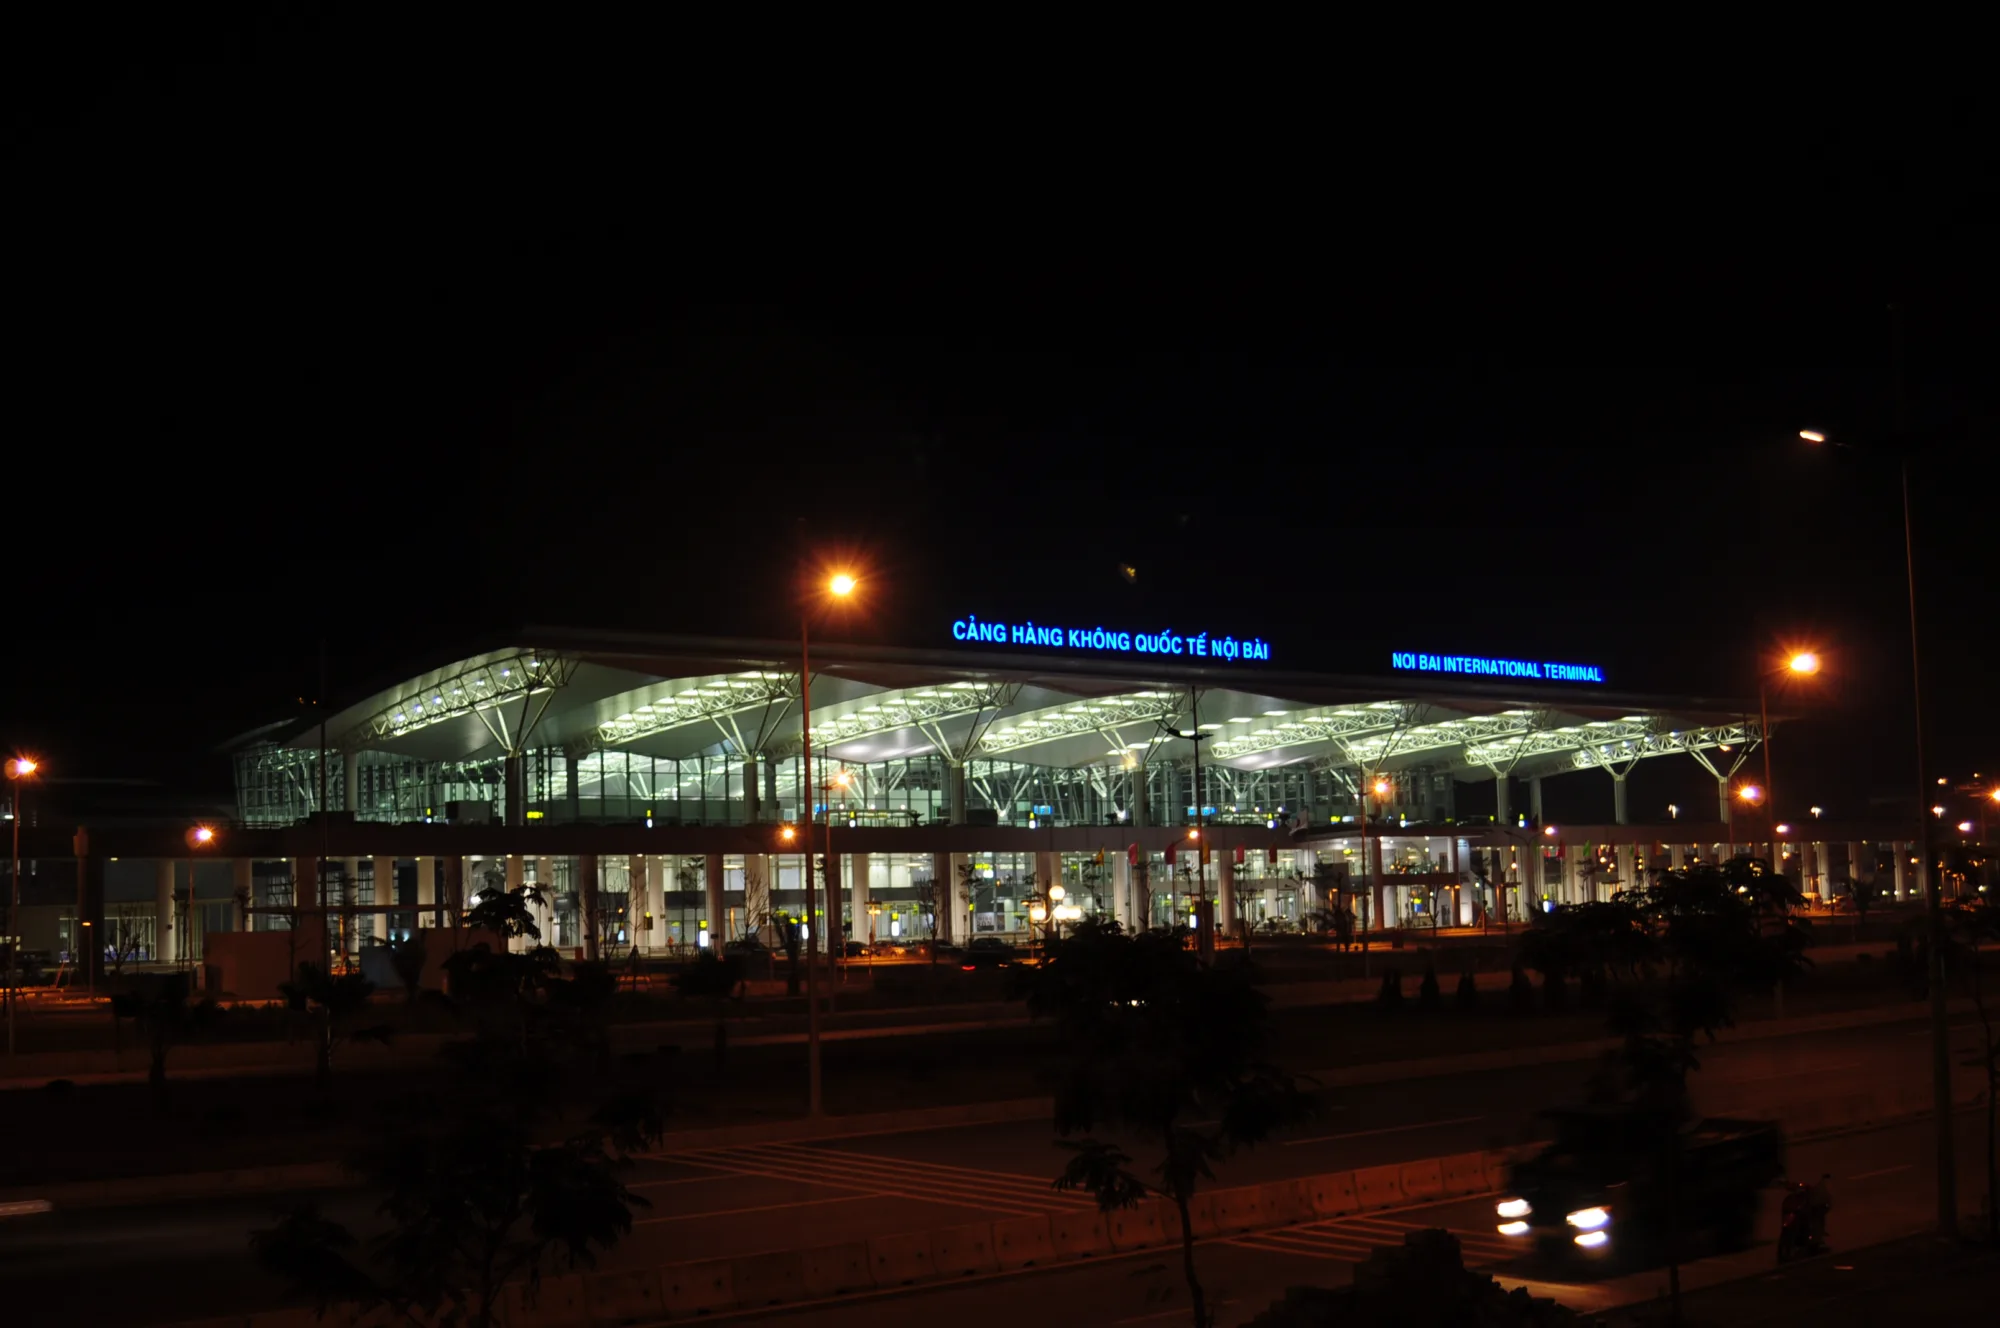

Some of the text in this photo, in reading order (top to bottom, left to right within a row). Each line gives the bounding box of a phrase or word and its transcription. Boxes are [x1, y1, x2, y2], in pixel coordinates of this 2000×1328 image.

[952, 615, 1269, 662] CẢNG HÀNG KHÔNG QUỐC TẾ NỘI BÀI
[1392, 652, 1602, 682] NOI BAI INTERNATIONAL TERMINAL
